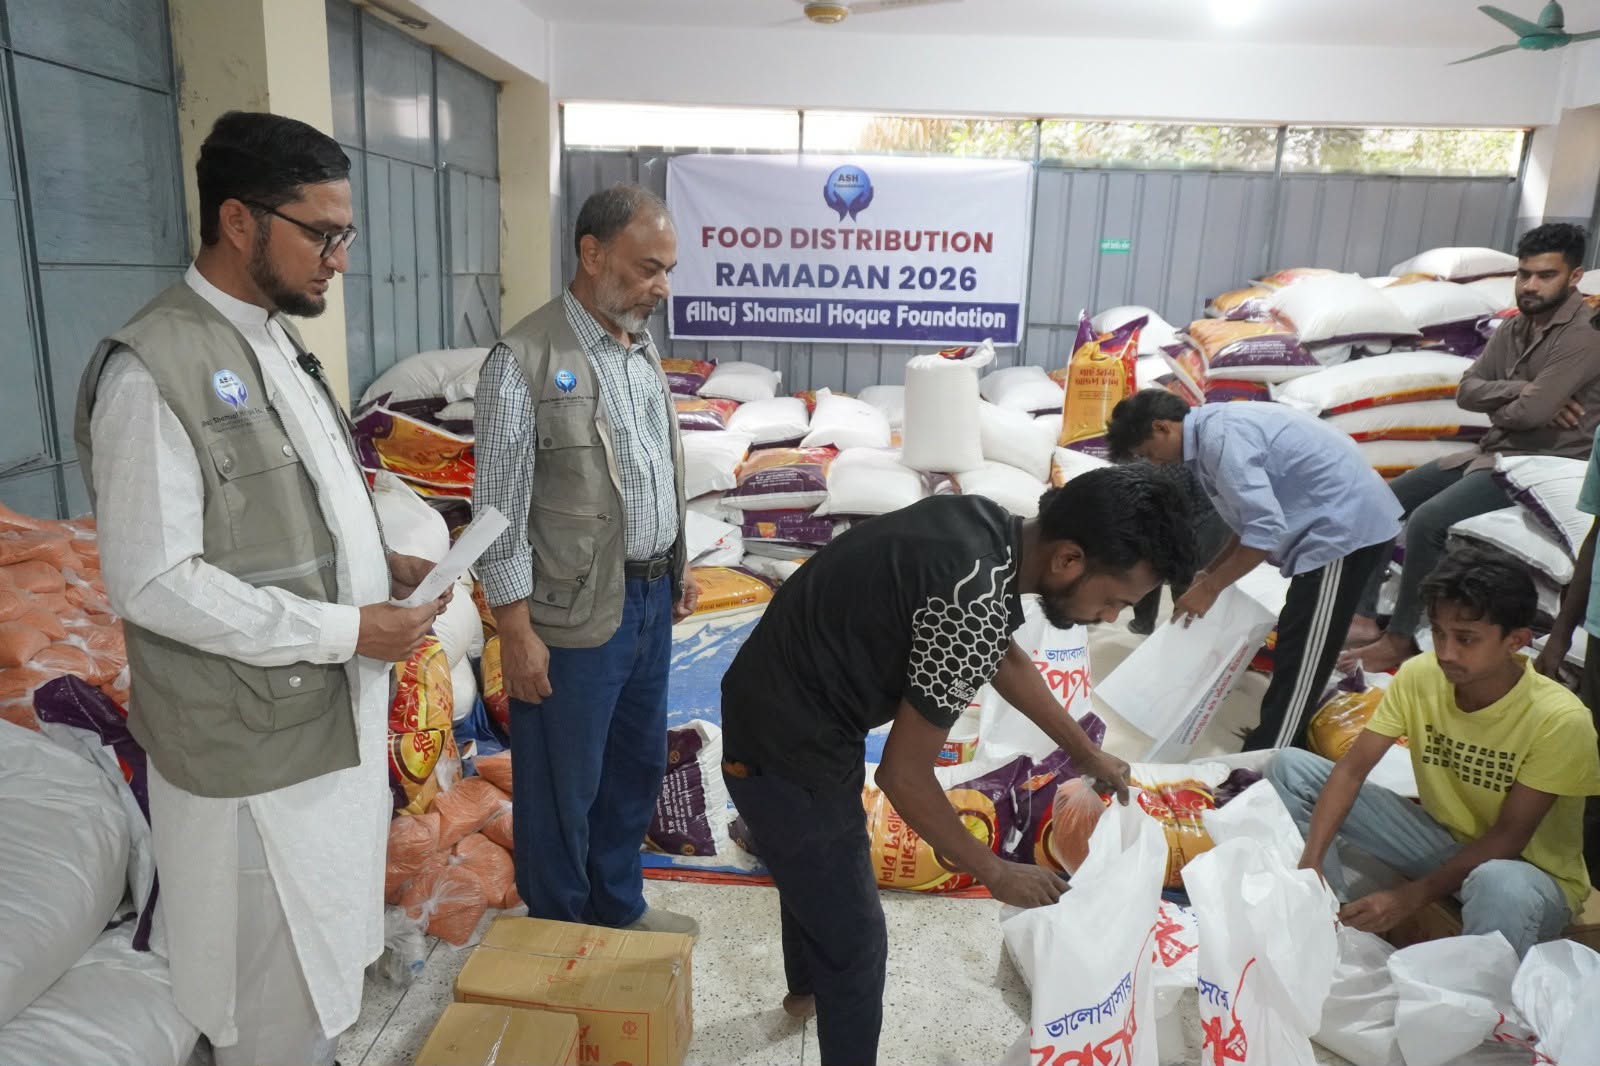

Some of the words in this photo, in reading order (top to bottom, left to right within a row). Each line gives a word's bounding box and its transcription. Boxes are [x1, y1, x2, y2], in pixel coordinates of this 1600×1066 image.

[838, 173, 859, 183] ASH
[701, 226, 783, 249] FOOD
[790, 228, 994, 254] DISTRIBUTION
[715, 262, 891, 290] RAMADAN
[898, 266, 978, 292] 2026
[685, 302, 737, 326] Alhaj
[742, 302, 822, 324] Shamsul
[828, 303, 890, 329] Hoque
[897, 305, 1007, 328] Foundation
